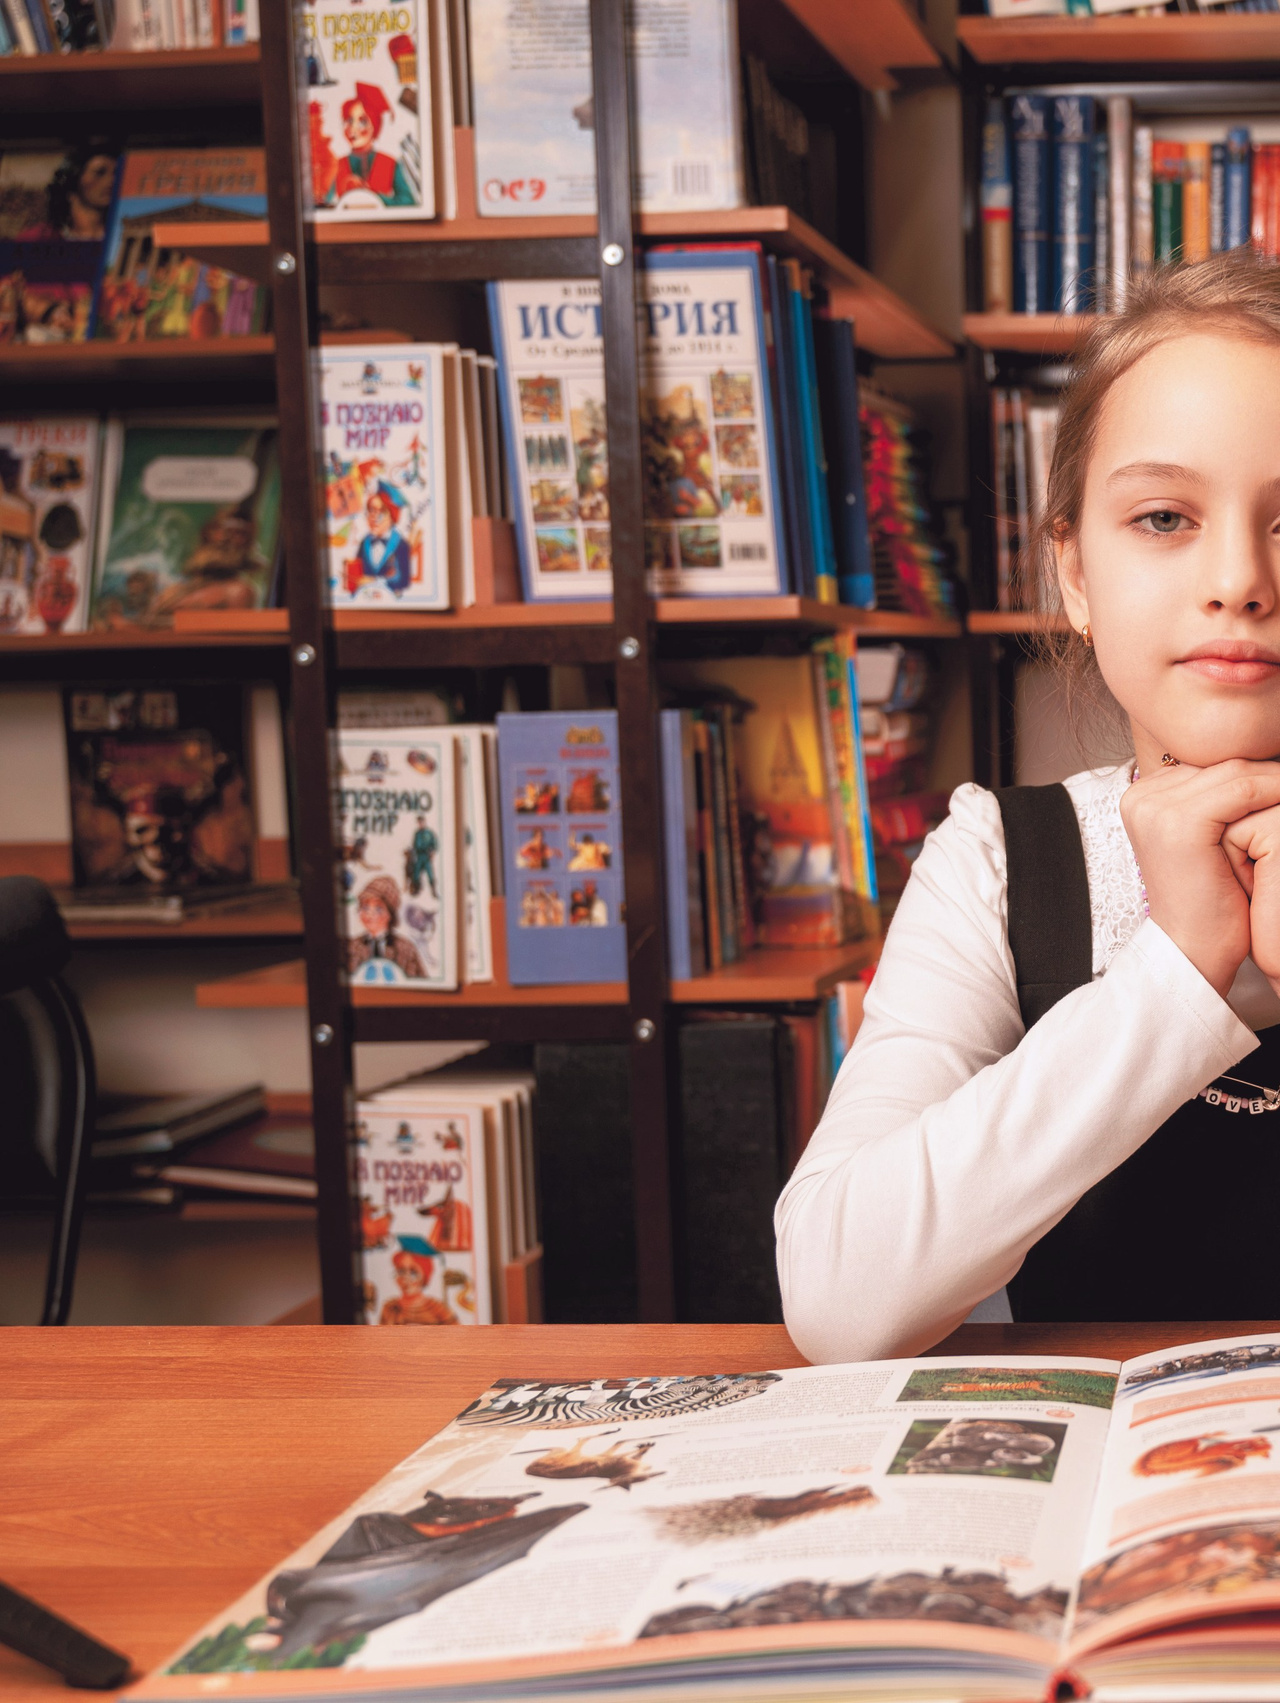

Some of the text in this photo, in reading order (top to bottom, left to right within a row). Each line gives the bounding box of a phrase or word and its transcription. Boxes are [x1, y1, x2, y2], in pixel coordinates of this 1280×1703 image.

[323, 9, 411, 37] ПОЗНАЮ
[333, 36, 378, 62] МИР
[517, 300, 739, 341] ИСТРИЯ
[336, 400, 423, 425] ПОЗНАЮ
[345, 427, 391, 449] МИР
[353, 812, 399, 835] МИР
[1208, 1092, 1261, 1113] OVE
[373, 1160, 463, 1183] ПОЗНАЮ
[384, 1182, 429, 1205] МИР
